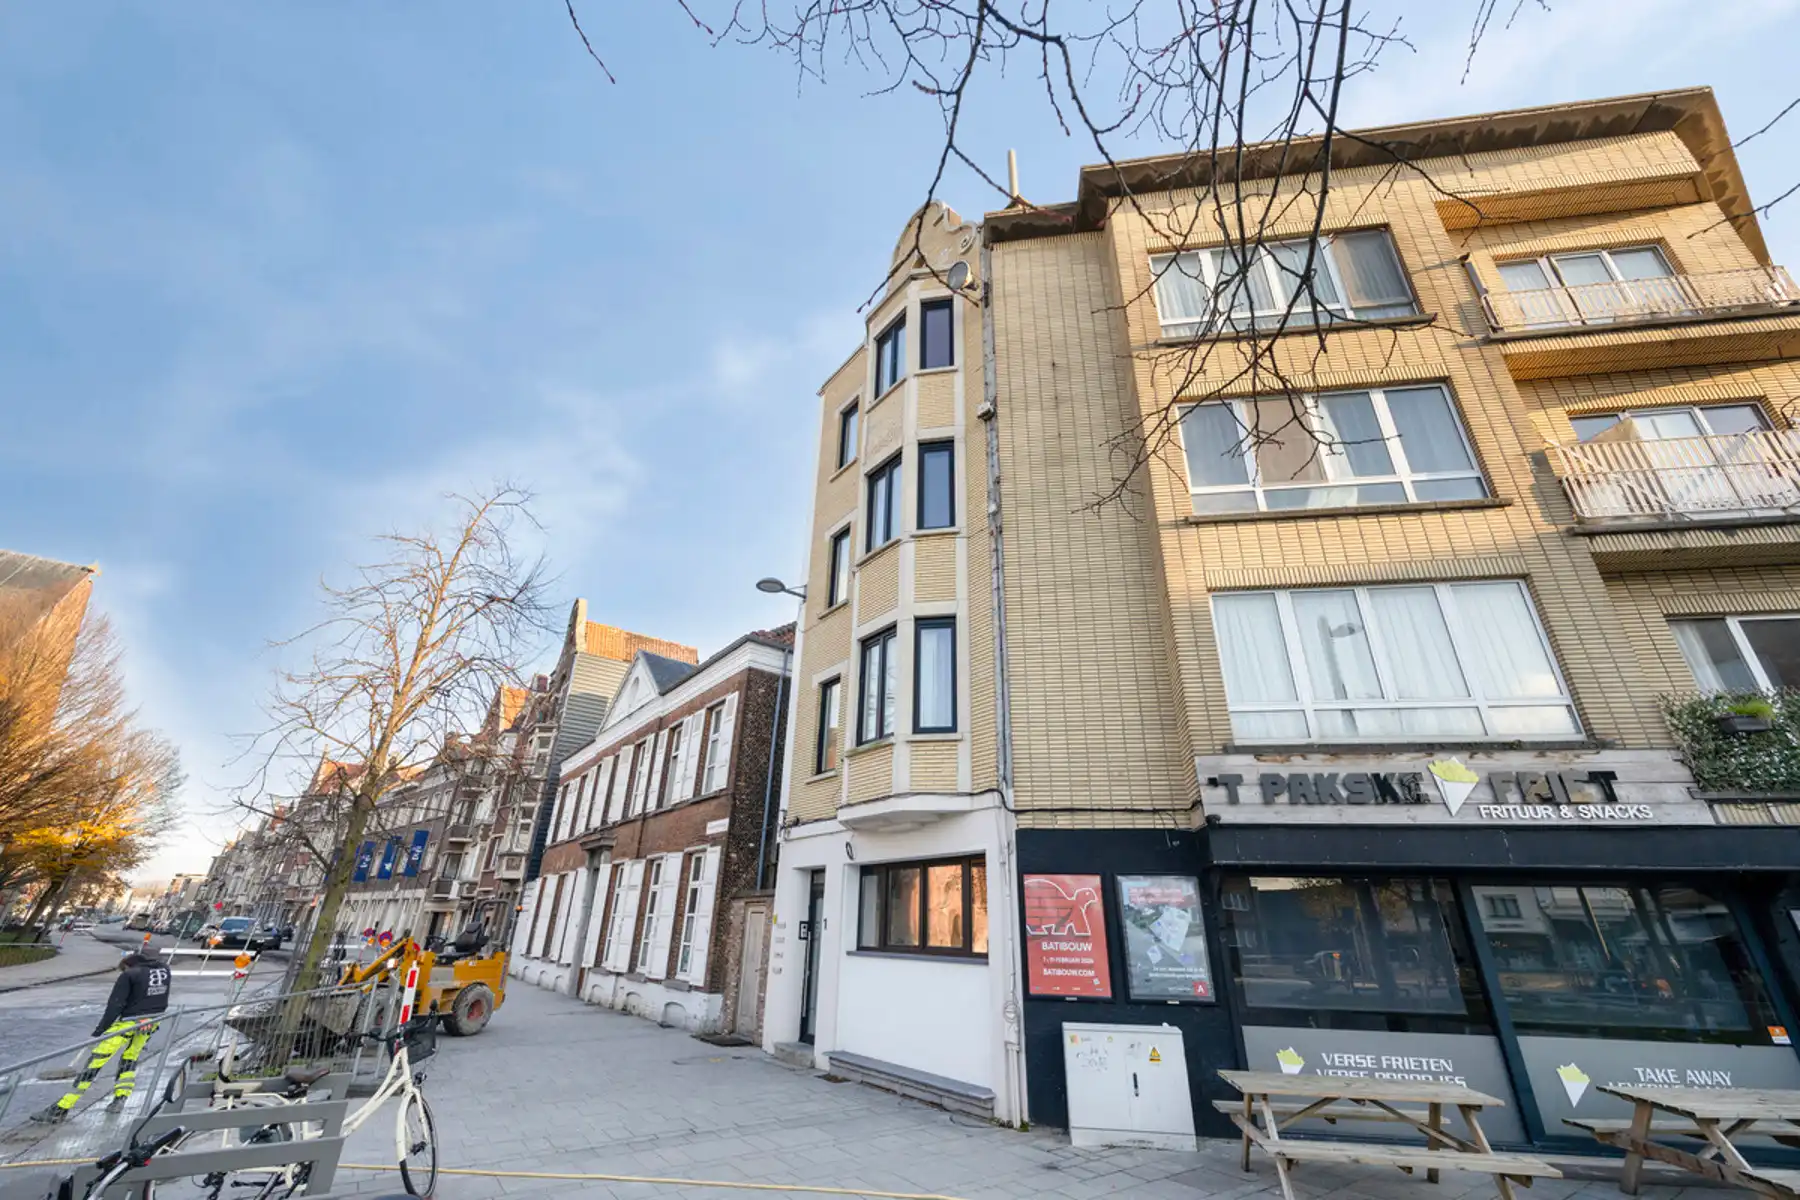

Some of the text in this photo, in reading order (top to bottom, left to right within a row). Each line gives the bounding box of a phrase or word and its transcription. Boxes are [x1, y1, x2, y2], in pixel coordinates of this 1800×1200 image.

[1488, 770, 1618, 804] FRIET
[1479, 804, 1654, 819] FRITUUR & SNACKS
[1042, 941, 1093, 951] BATIBOUW
[1043, 968, 1095, 977] BATIBOUW.COM
[1321, 1052, 1453, 1073] VERSE FRIETEN
[1633, 1067, 1681, 1084] TAKE
[1686, 1069, 1732, 1086] AWAY
